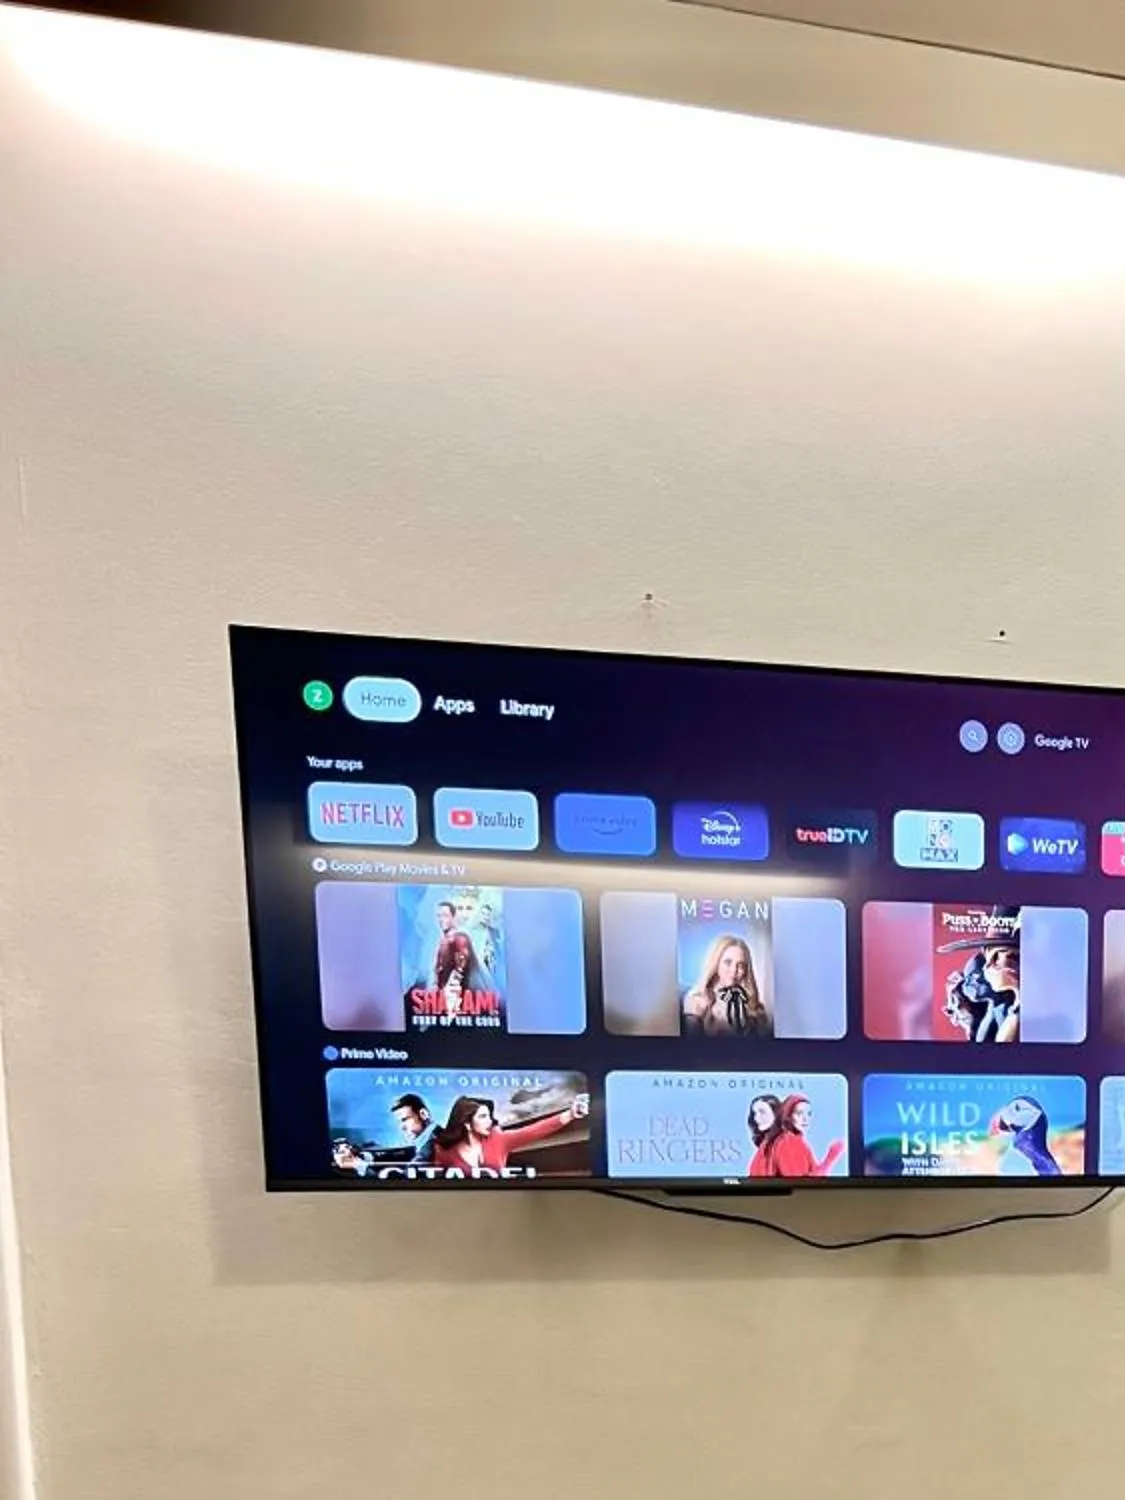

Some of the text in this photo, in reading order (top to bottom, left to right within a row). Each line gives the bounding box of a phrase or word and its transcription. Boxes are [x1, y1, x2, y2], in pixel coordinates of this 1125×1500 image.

[361, 692, 407, 707] Home
[433, 696, 475, 714] Apps
[500, 700, 555, 720] Library
[1034, 733, 1090, 750] Google TV
[307, 756, 364, 772] Your apps
[320, 802, 405, 829] NETFLIX
[475, 811, 525, 830] YouTube
[1032, 838, 1079, 855] WeTV
[330, 860, 466, 876] Google Play Movies & TV
[341, 1048, 409, 1061] Prime Video
[375, 1075, 544, 1087] AMAZON ORIGINAL
[652, 1079, 805, 1090] AMAZON ORIGINAL
[896, 1101, 982, 1127] WILD
[649, 1115, 709, 1137] DEAD
[617, 1138, 742, 1165] RINGERS
[902, 1131, 980, 1155] ISLES
